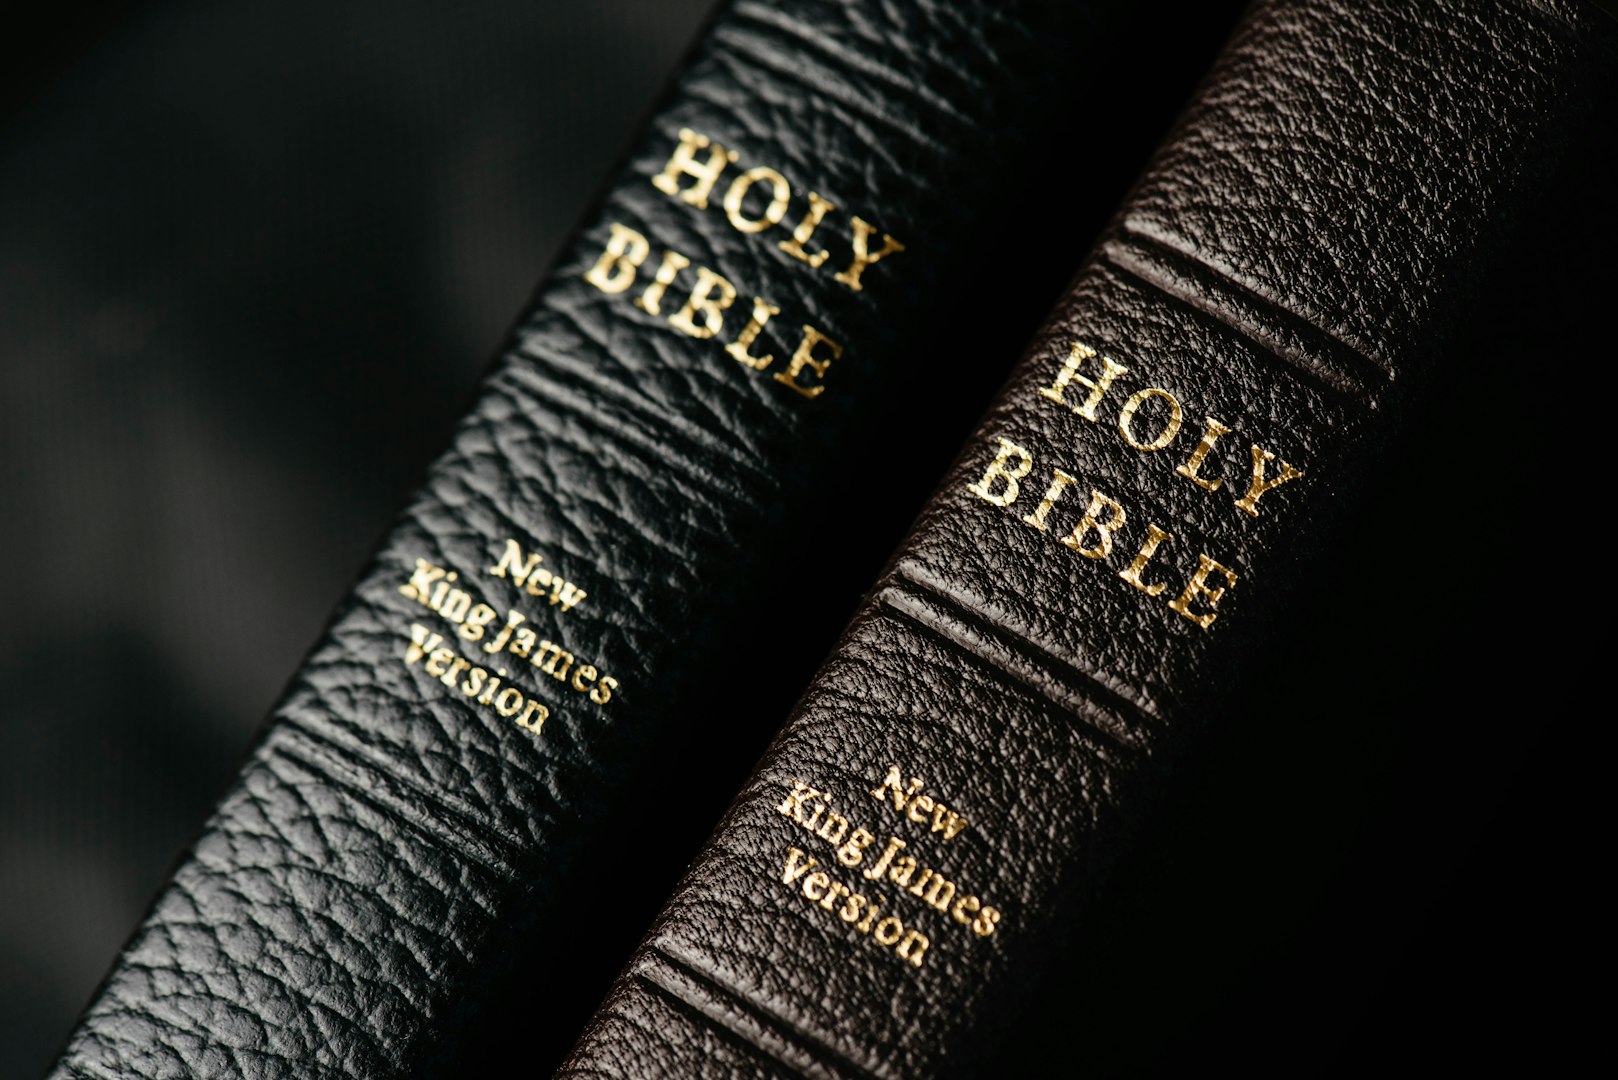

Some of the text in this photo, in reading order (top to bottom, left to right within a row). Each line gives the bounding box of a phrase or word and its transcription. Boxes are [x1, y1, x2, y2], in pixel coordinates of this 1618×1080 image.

[652, 127, 905, 292] HOLY
[584, 223, 843, 398] BIBLE
[1038, 342, 1303, 517] HOLY
[489, 538, 588, 612] New
[966, 436, 1239, 628] BIBLE
[398, 557, 619, 704] King James
[404, 623, 549, 735] Version
[775, 778, 1001, 937] King James
[870, 765, 969, 840] New
[783, 847, 930, 967] Version
